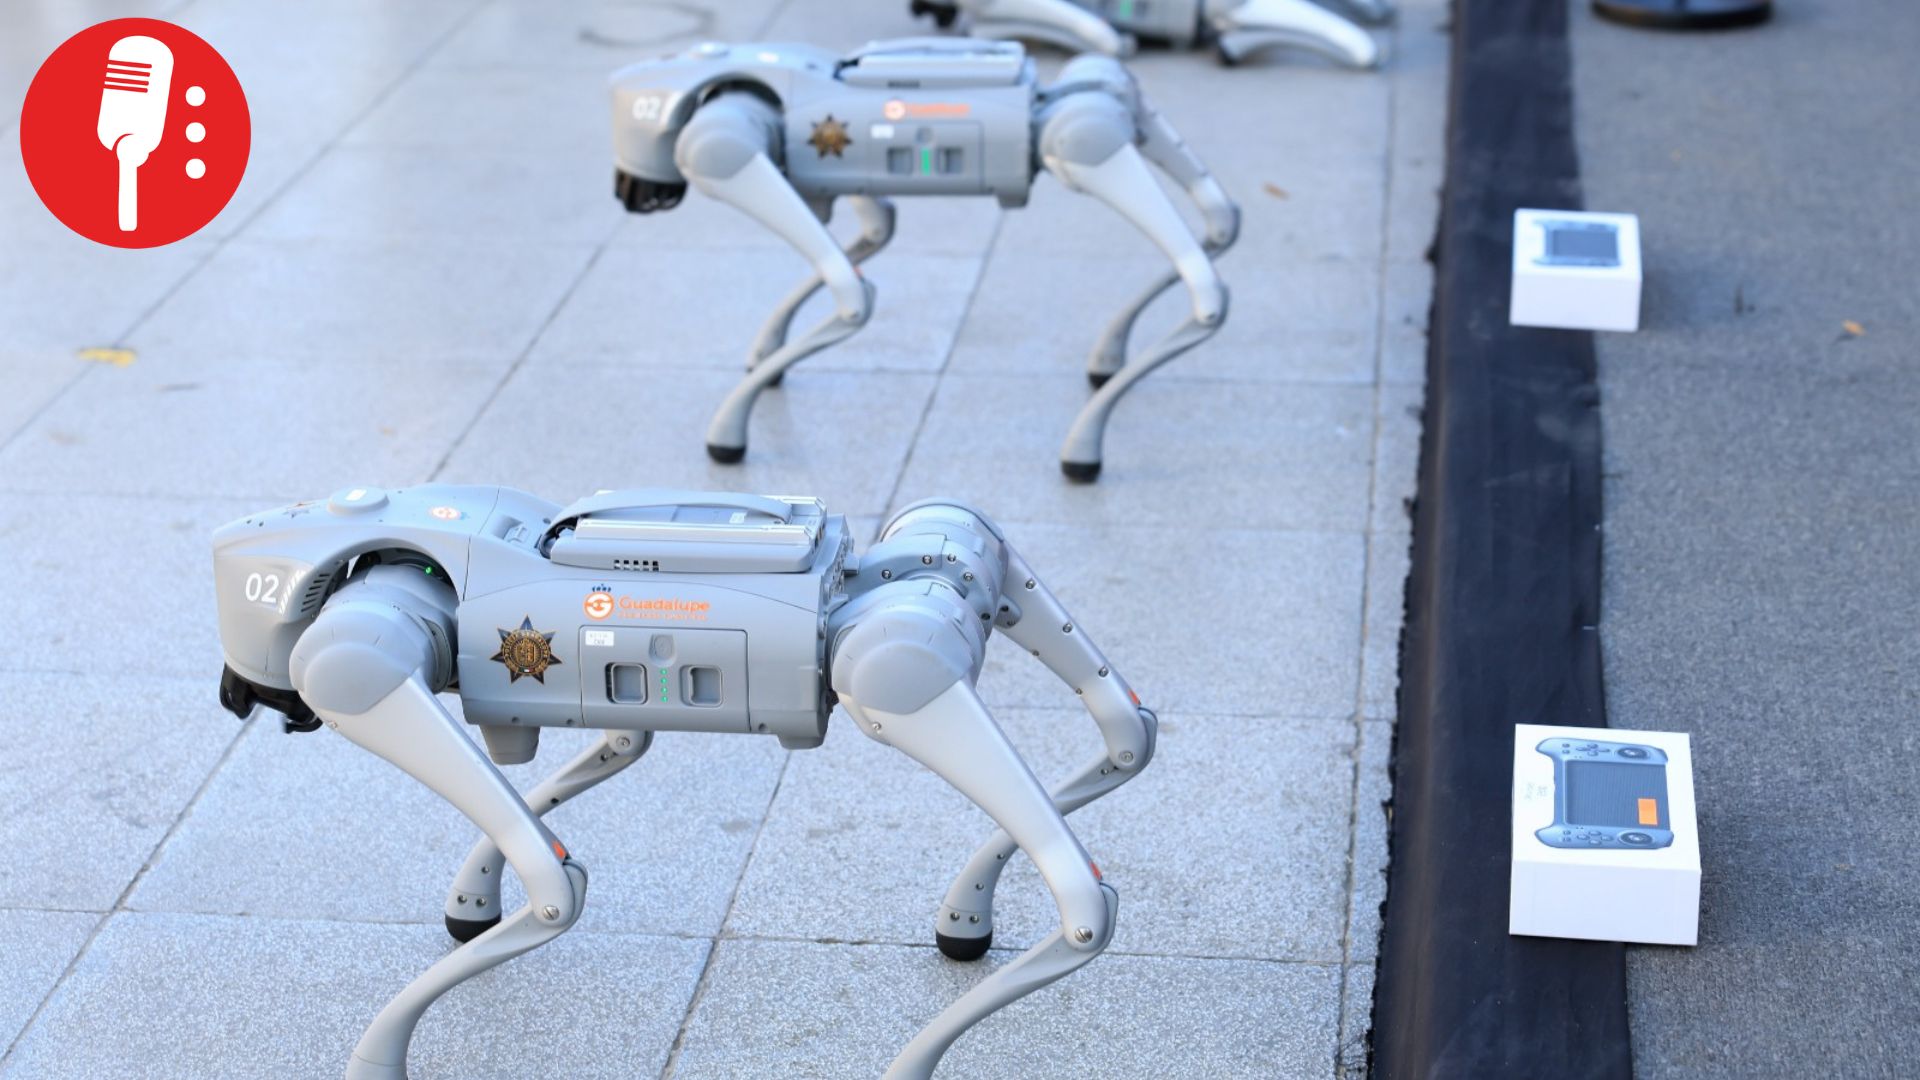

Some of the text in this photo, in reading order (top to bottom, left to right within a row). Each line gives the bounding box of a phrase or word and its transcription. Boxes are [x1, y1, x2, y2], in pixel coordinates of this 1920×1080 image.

[632, 96, 661, 120] 02
[245, 572, 280, 604] 02
[619, 595, 710, 613] Guadalupe
